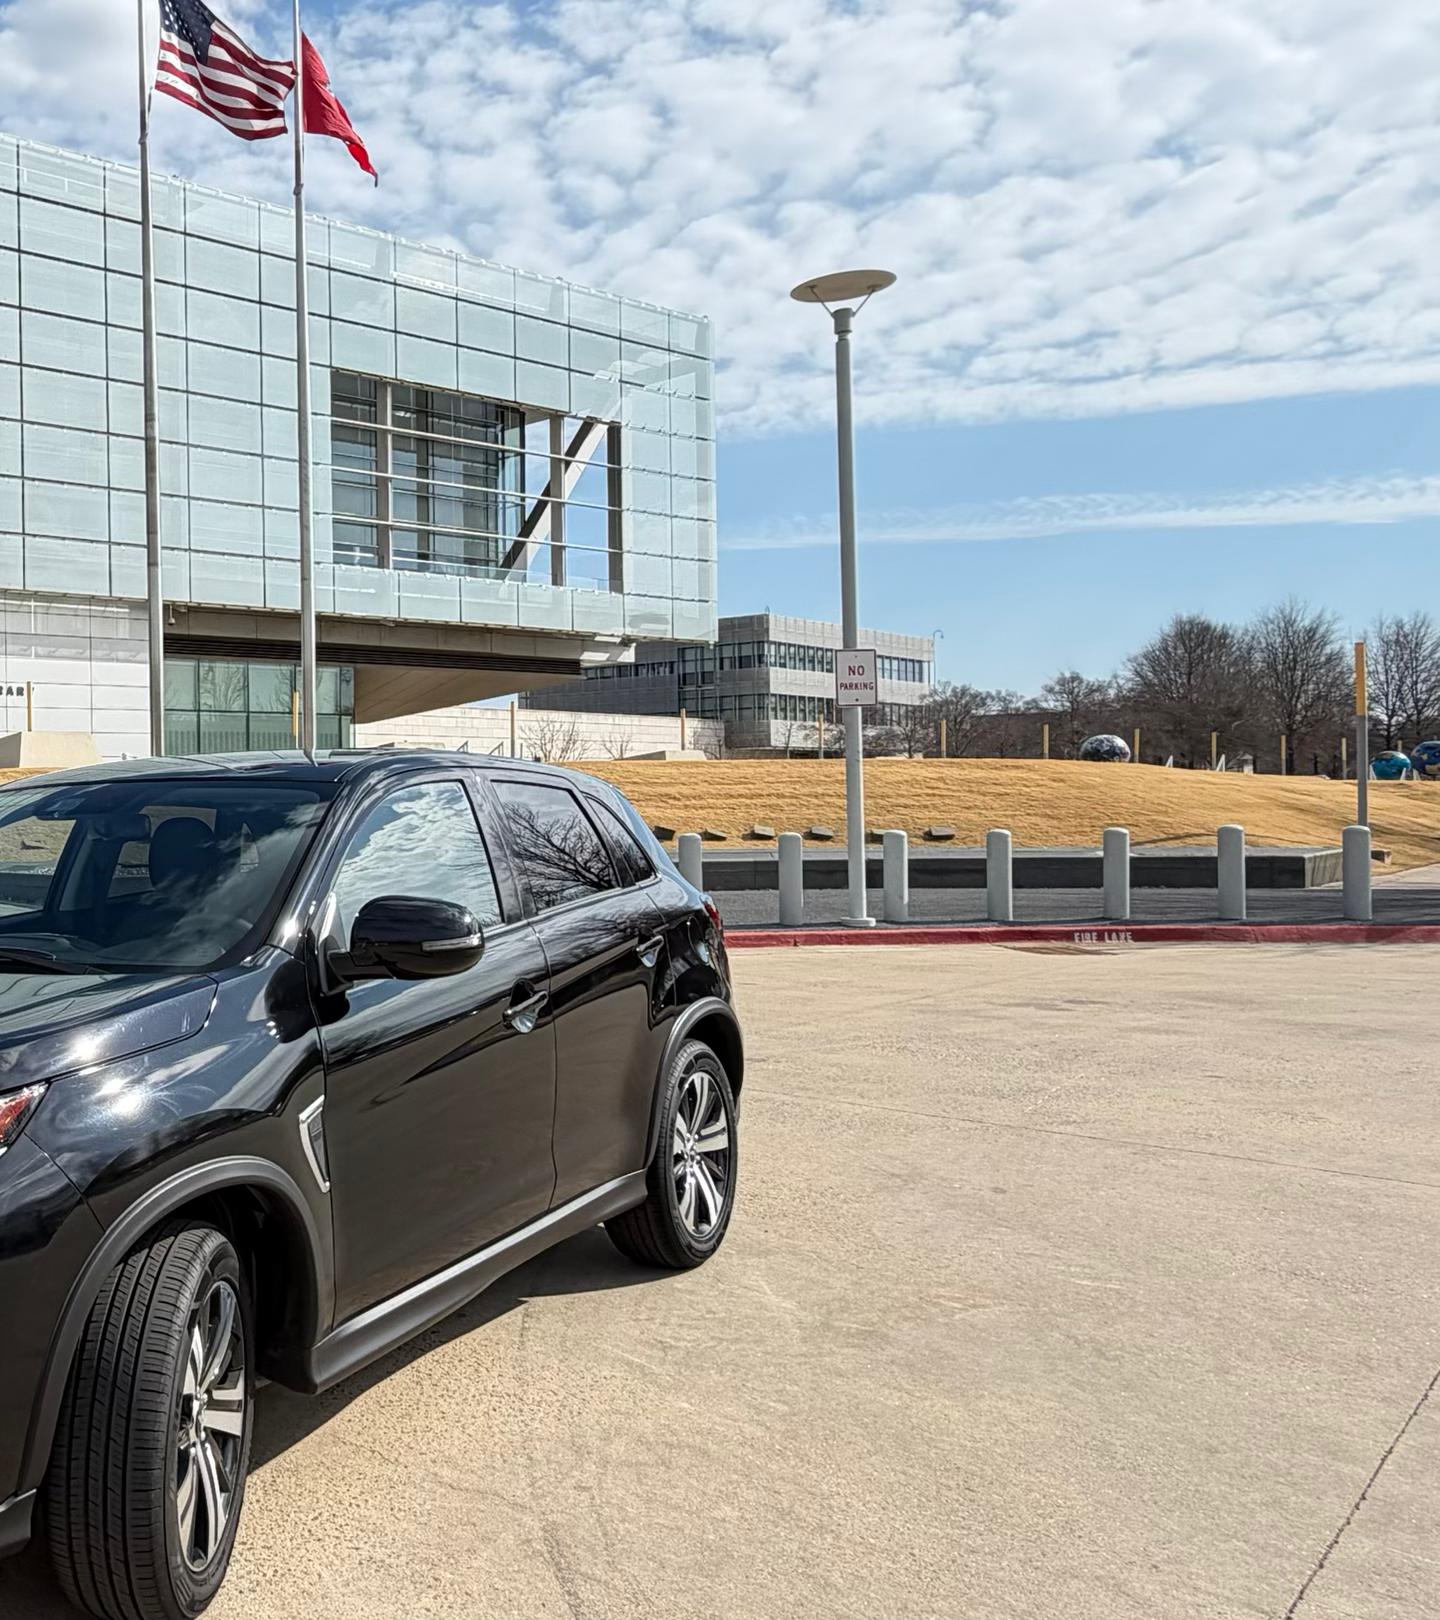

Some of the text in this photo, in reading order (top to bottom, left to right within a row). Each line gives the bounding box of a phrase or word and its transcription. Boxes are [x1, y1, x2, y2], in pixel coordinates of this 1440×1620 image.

[848, 665, 865, 676] NO
[839, 682, 874, 691] PARKING
[1074, 932, 1134, 943] FIRE LANE
